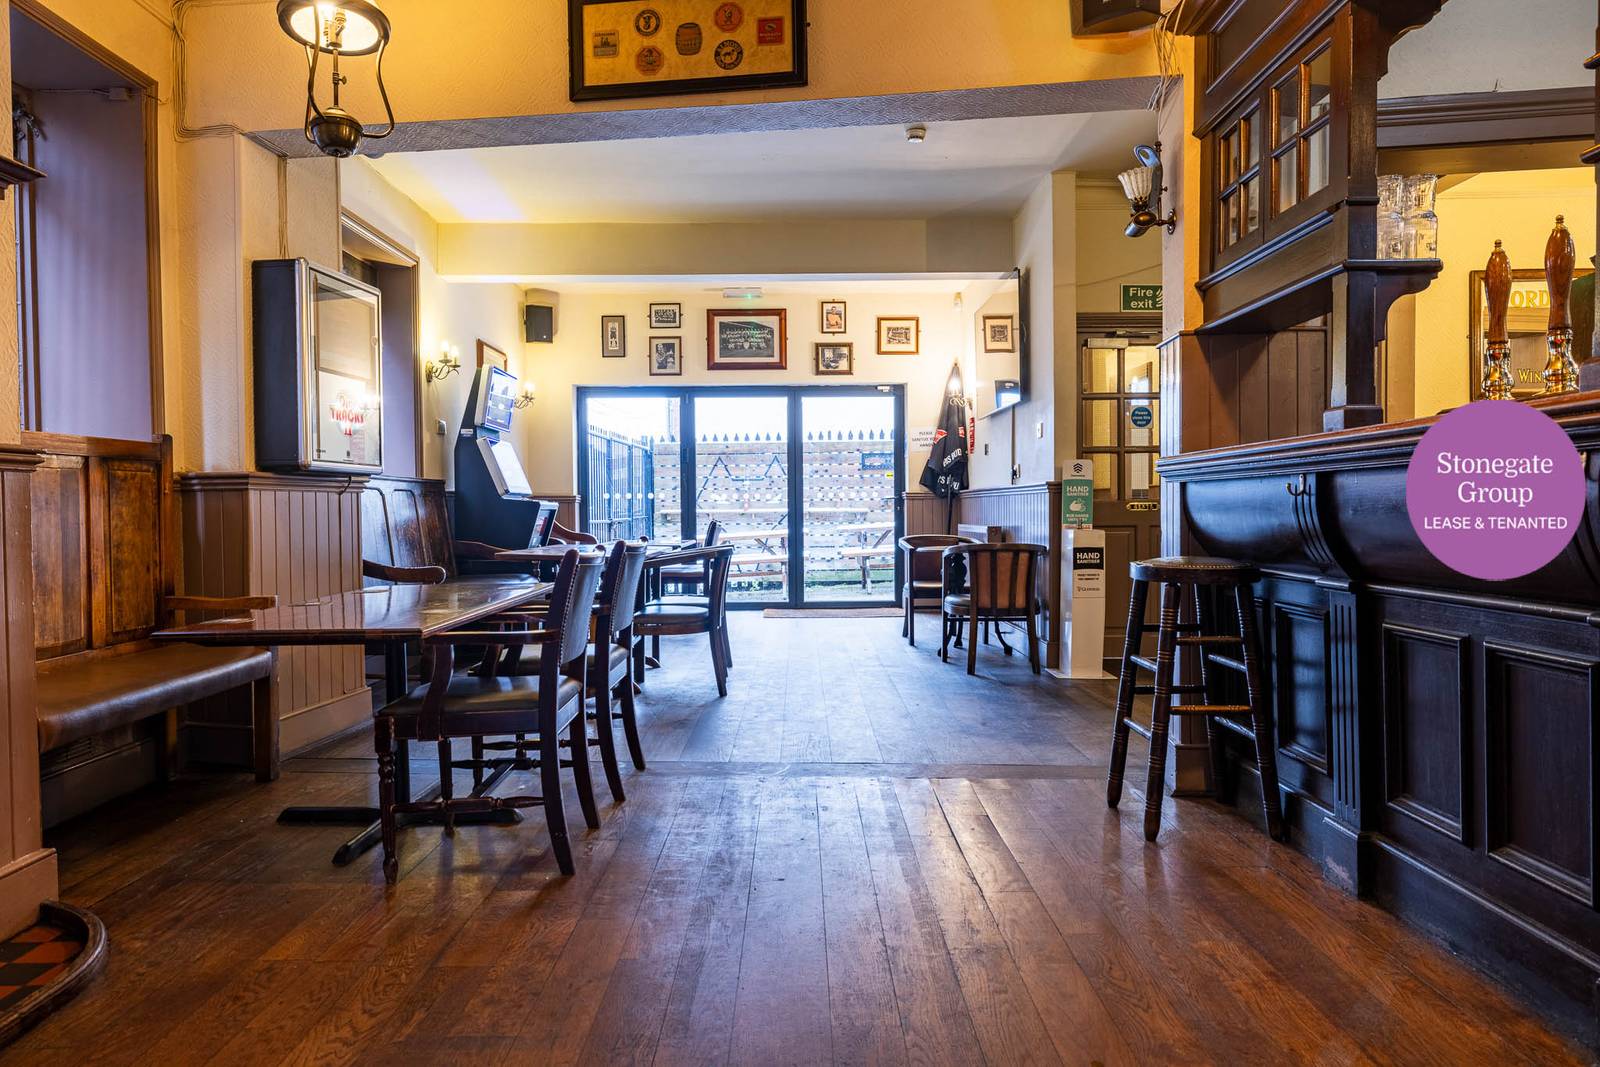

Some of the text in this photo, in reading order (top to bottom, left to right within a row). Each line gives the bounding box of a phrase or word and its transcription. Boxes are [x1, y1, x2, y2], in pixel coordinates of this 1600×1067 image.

[1129, 287, 1153, 297] Fire
[1130, 299, 1153, 309] exit
[1076, 552, 1100, 560] HAND
